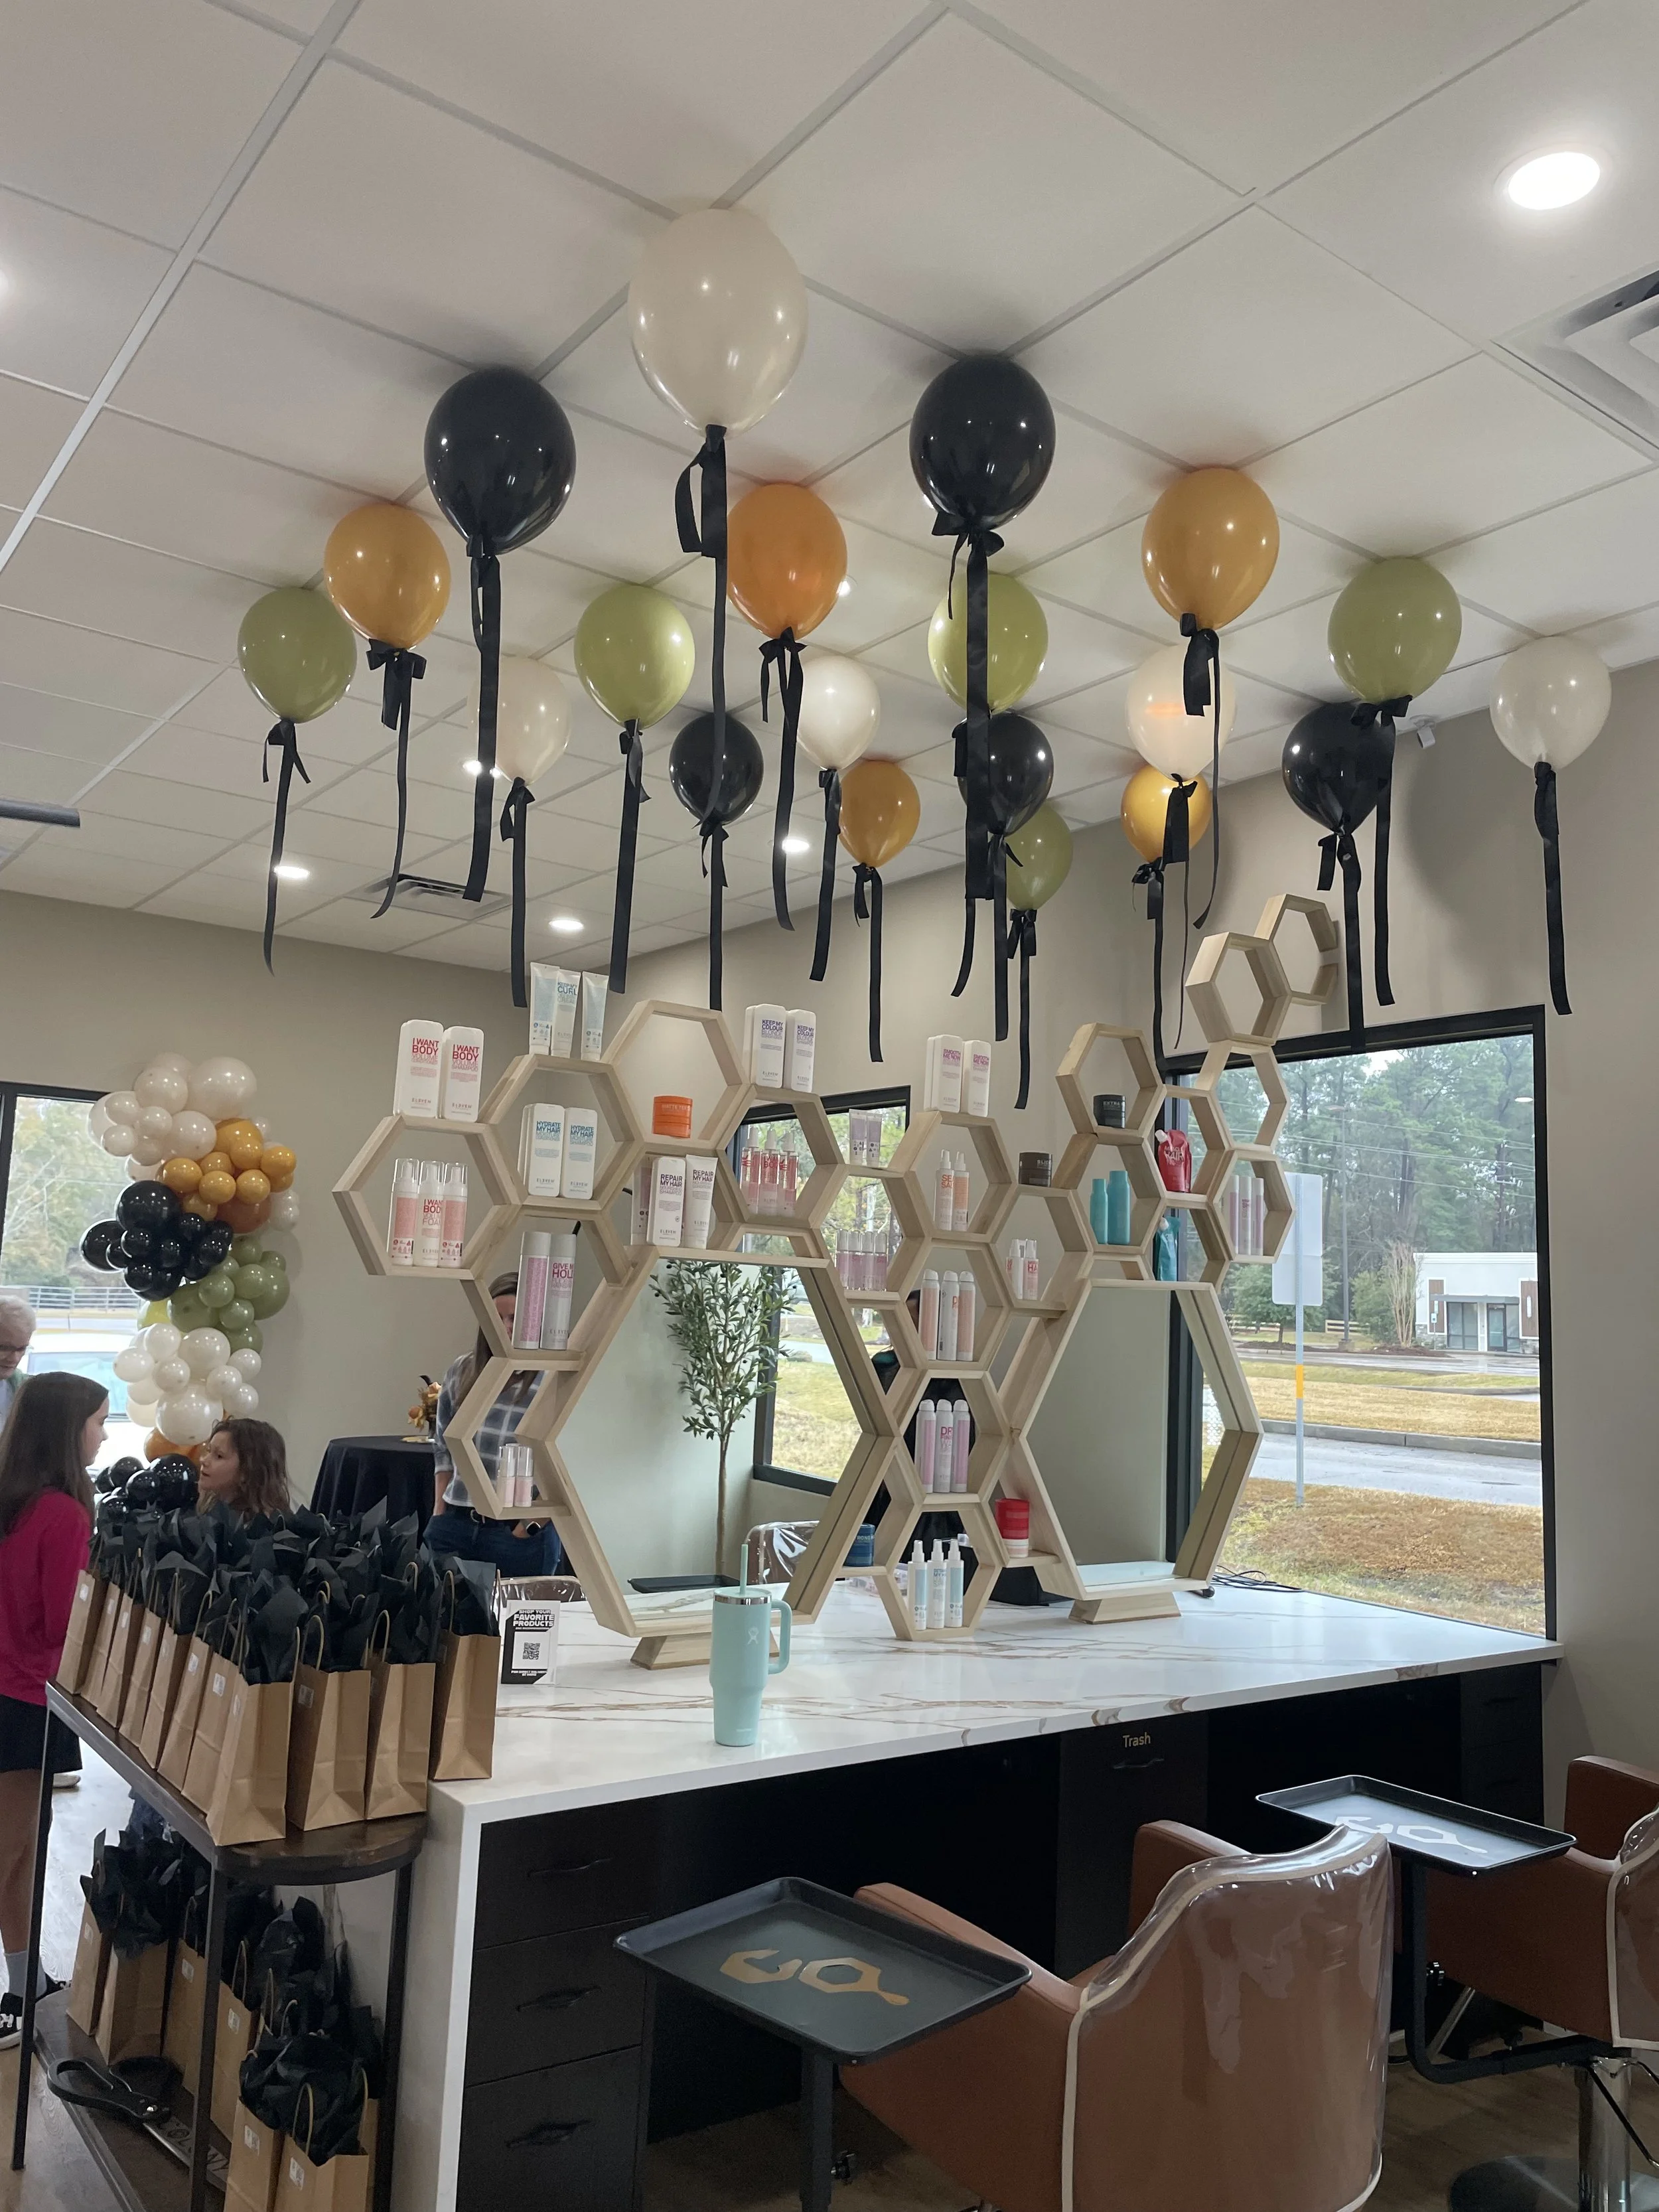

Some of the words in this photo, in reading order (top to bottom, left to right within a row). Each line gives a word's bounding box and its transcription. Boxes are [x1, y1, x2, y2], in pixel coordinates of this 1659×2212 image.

[557, 986, 577, 995] CURL
[417, 1038, 439, 1047] WANT
[412, 1045, 439, 1055] BODY
[457, 1045, 480, 1054] WANT
[453, 1051, 479, 1062] BODY
[1122, 1732, 1151, 1747] Trash
